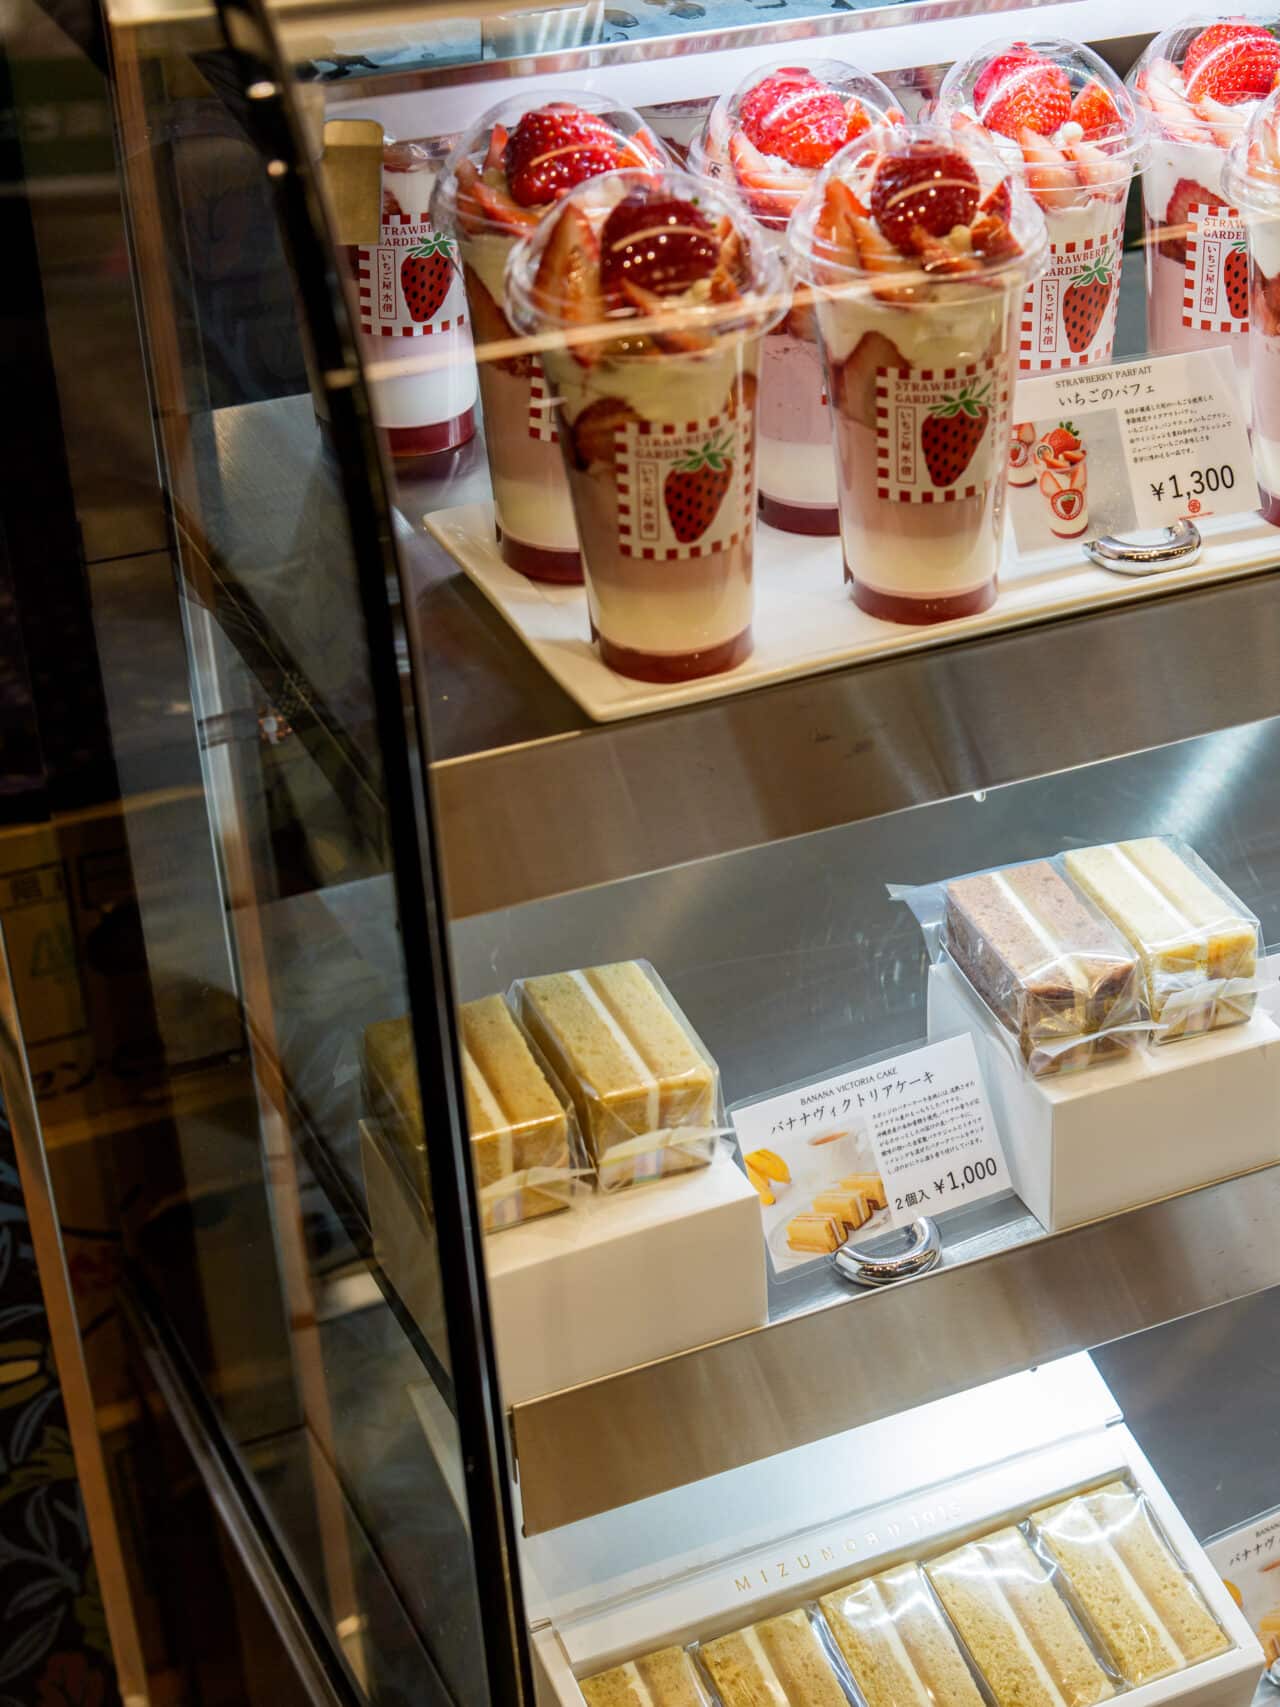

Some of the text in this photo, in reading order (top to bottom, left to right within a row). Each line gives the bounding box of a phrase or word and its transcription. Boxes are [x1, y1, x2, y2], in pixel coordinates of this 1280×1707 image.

[384, 236, 425, 247] ARDEN
[1055, 365, 1153, 389] STRAWBERRY PARFAIT
[1058, 383, 1156, 408] いちごのパフェ
[1150, 464, 1235, 501] ¥1,300
[772, 1072, 935, 1134] バナナヴィクトリアケーキ
[800, 1066, 899, 1106] BANANA VICTORIA CAKE
[895, 1156, 998, 1211] 2個入 ¥1,000
[735, 1523, 902, 1593] MIZUNOBU
